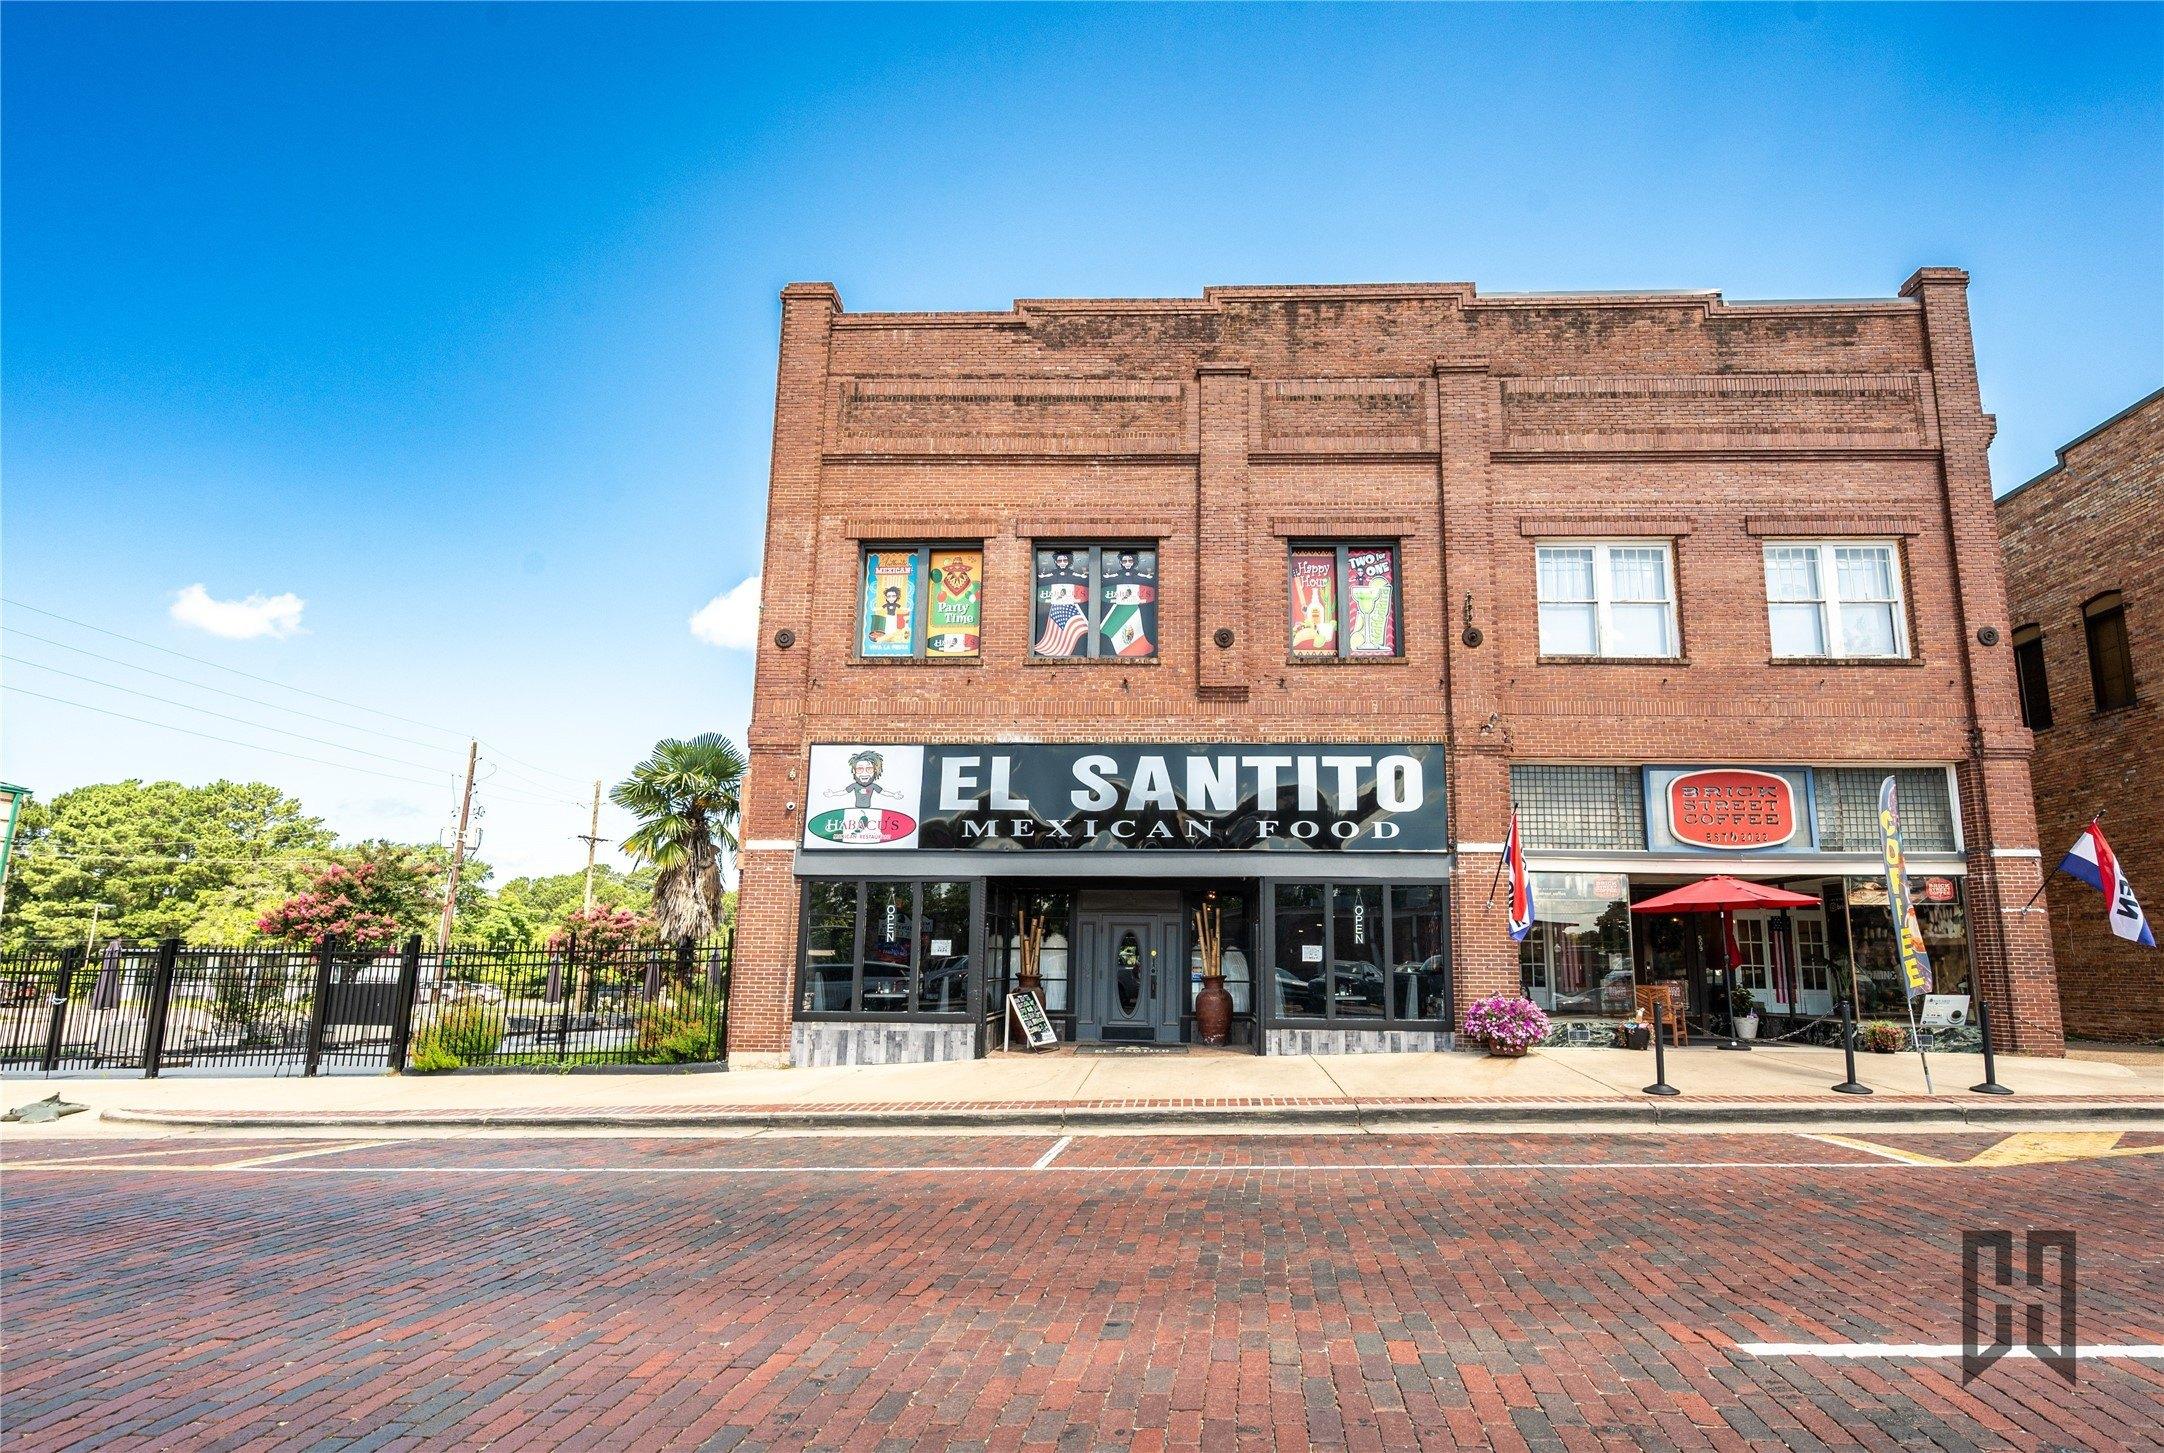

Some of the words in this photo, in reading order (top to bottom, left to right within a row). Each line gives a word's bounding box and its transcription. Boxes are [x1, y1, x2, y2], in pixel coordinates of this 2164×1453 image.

[1298, 561, 1330, 575] Happy
[1348, 554, 1375, 569] TWO
[1366, 562, 1390, 576] ONE
[1301, 575, 1328, 587] Hour
[938, 603, 969, 615] Party
[944, 613, 974, 624] Time
[938, 756, 1030, 811] EL
[1070, 755, 1424, 812] SANTITO
[1681, 786, 1779, 798] BRICK
[1683, 799, 1780, 812] STREET
[1684, 813, 1780, 826] COFFEE
[961, 819, 1213, 839] MEXICAN
[1256, 819, 1402, 839] FOOD
[1741, 832, 1769, 843] 2022
[886, 905, 896, 942] OPEN
[1354, 905, 1364, 944] OPEN
